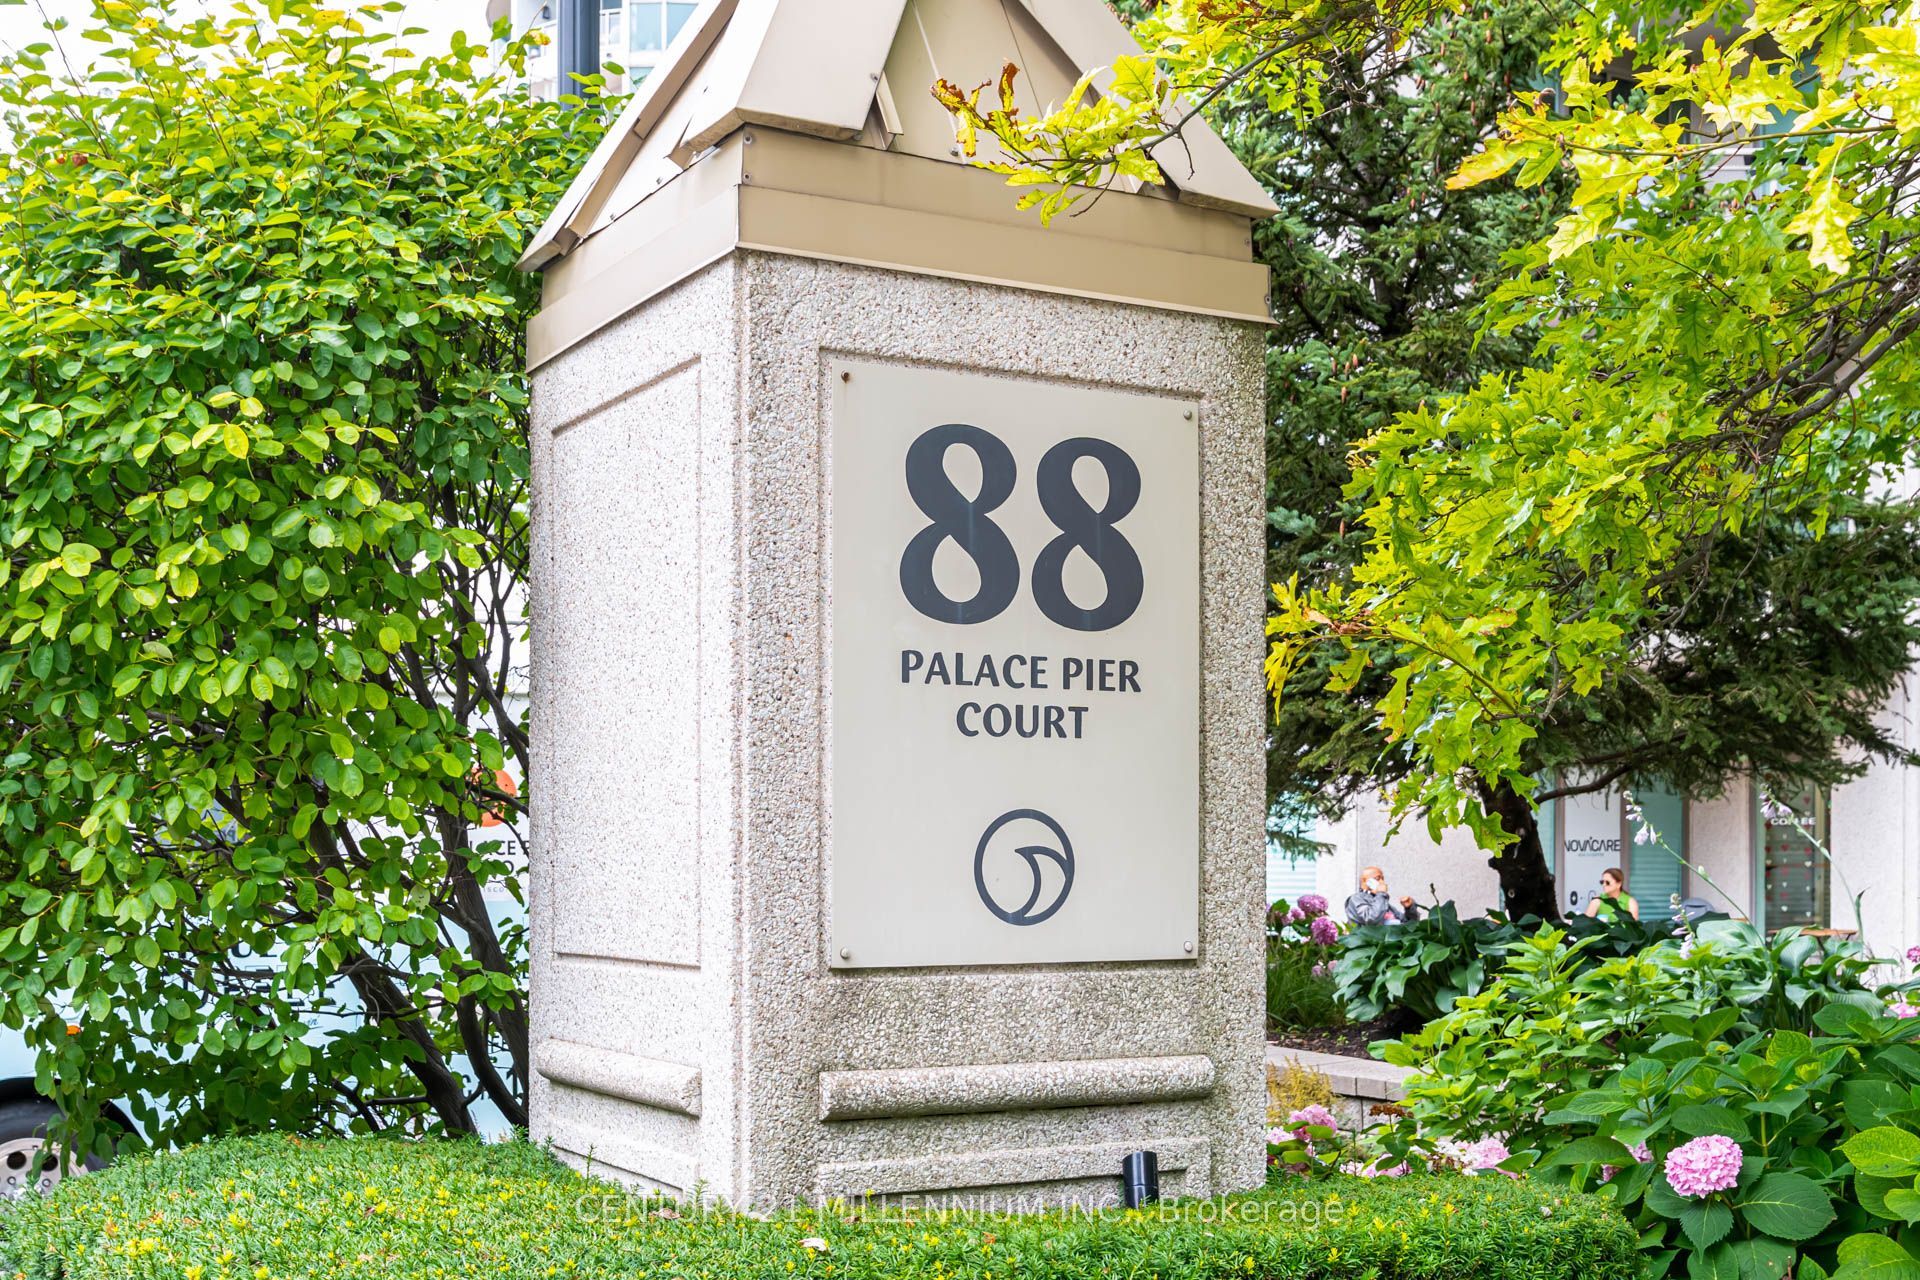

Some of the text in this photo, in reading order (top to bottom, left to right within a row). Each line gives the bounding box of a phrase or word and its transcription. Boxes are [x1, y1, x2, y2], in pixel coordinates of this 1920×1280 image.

[900, 424, 1144, 632] 88
[901, 649, 1142, 693] PALACE PIER
[956, 701, 1089, 739] COURT
